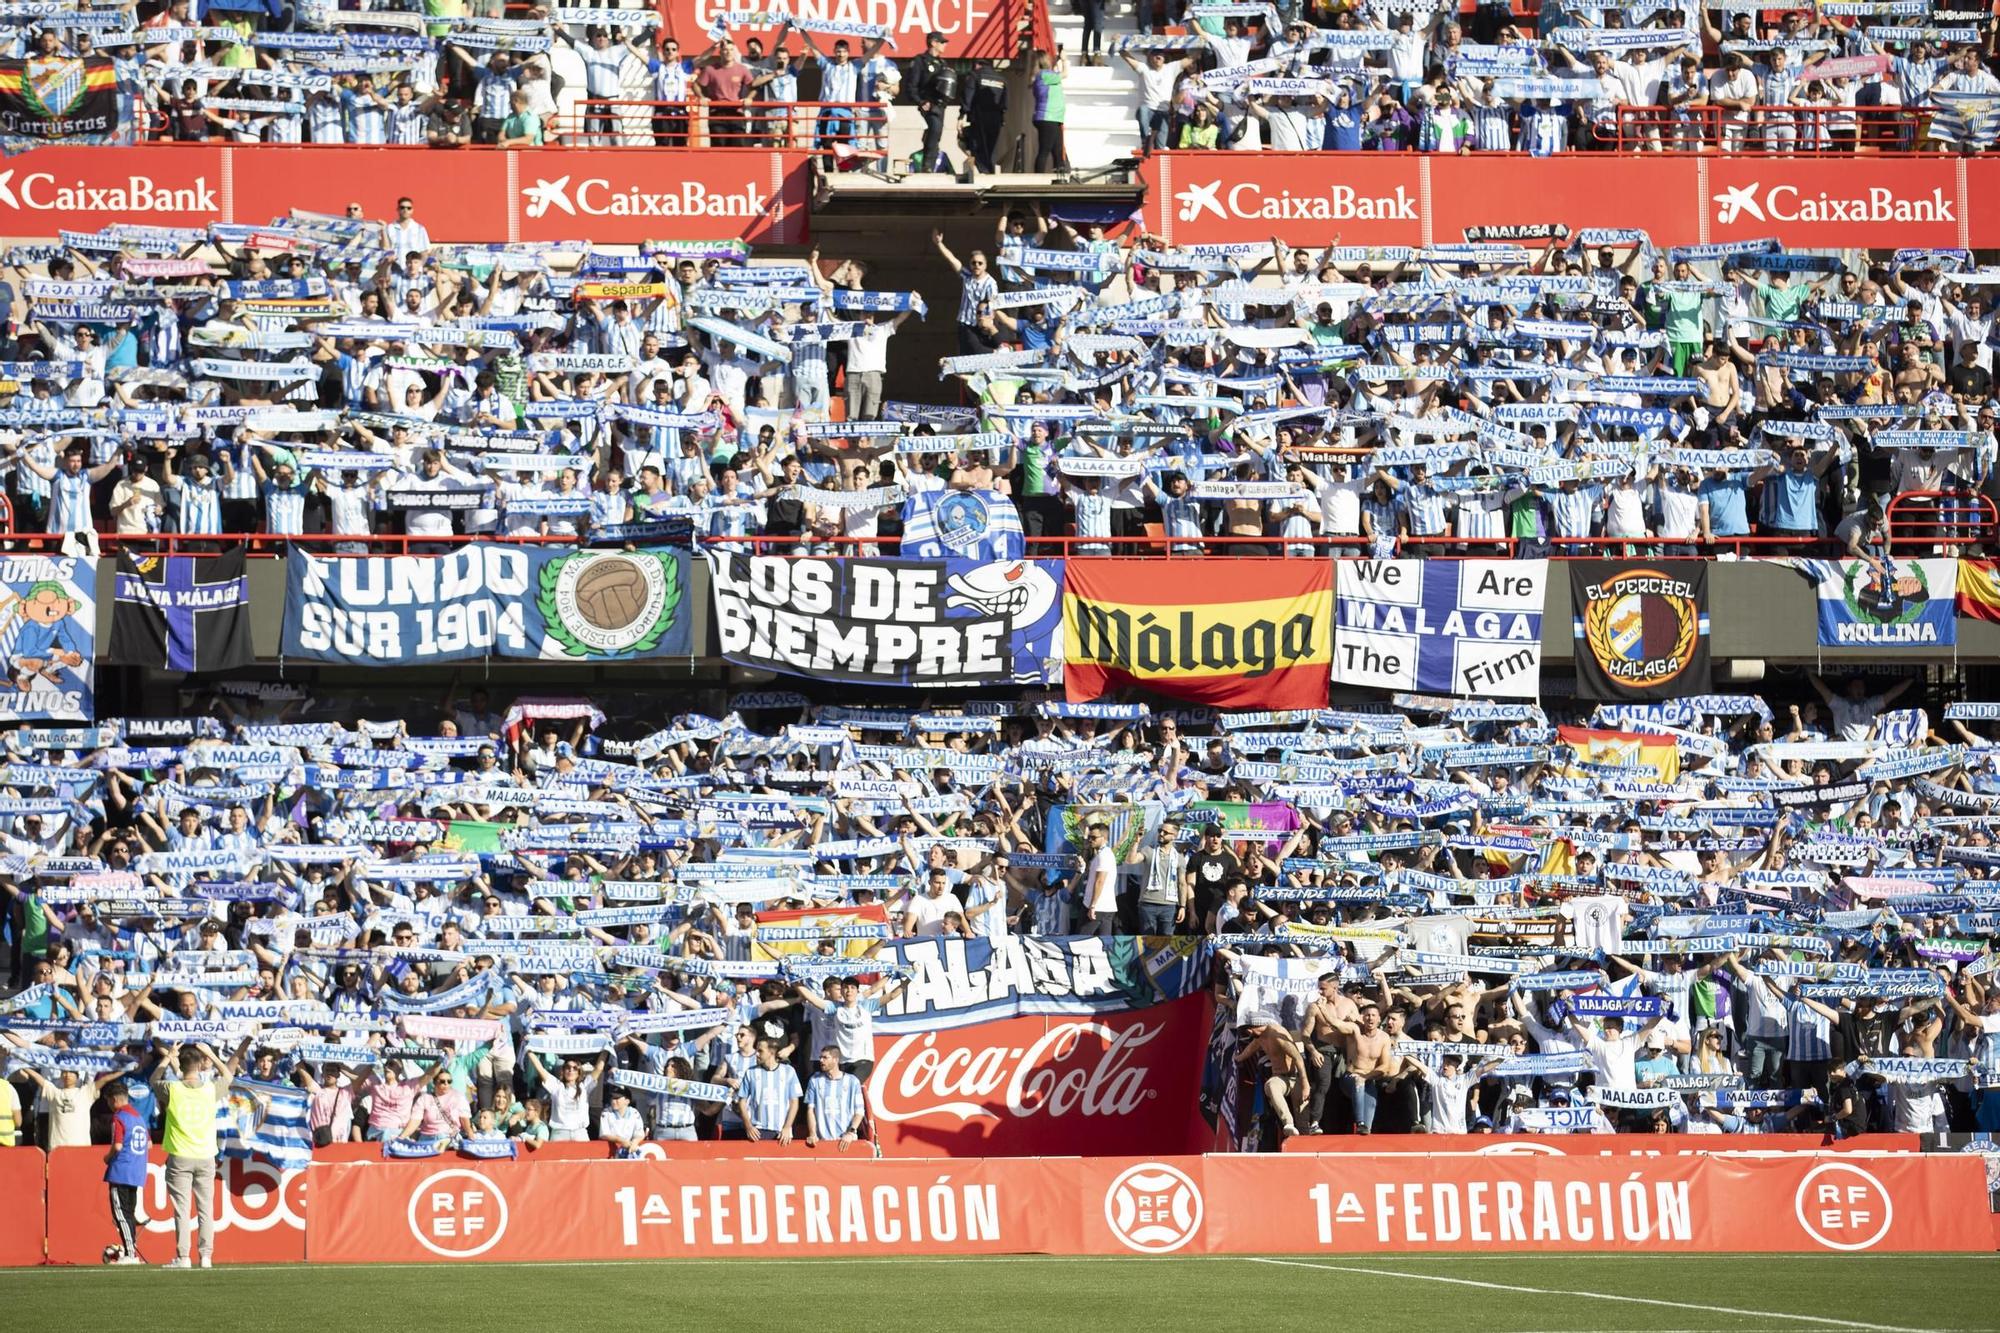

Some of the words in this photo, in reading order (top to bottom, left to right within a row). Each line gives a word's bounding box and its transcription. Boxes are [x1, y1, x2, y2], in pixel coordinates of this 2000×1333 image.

[563, 8, 599, 21] LOS
[602, 10, 643, 22] 300
[1827, 5, 1874, 15] FONDO
[1892, 3, 1920, 14] SUR
[805, 20, 879, 35] MALAGA
[1874, 28, 1923, 41] FONDO
[1941, 29, 1971, 41] SUR
[262, 32, 341, 48] MALAGA
[348, 34, 423, 49] MALAGA
[1326, 34, 1371, 45] MALAGA
[1550, 84, 1580, 93] MALAGA
[20, 172, 219, 212] CaixaBank
[576, 177, 766, 216] CaixaBank
[1229, 183, 1417, 220] CaixaBank
[1767, 185, 1956, 223] CaixaBank
[1485, 225, 1551, 241] MALAGA
[67, 234, 119, 249] FONDO
[1750, 257, 1818, 270] MALAGA
[1409, 278, 1477, 292] MALAGA
[1004, 293, 1025, 304] MCF
[1468, 288, 1531, 301] MALAGA
[33, 304, 77, 318] MALAKA
[80, 302, 132, 318] HINCHAS
[556, 356, 605, 370] MALAGA
[1785, 355, 1860, 371] MALAGA
[1419, 366, 1449, 380] SUR
[1609, 377, 1691, 393] MALAGA
[1495, 406, 1548, 418] MALAGA
[1549, 406, 1566, 418] C.F.
[1596, 408, 1665, 426] MALAGA
[1765, 420, 1836, 437] MALAGA
[488, 437, 537, 451] GRANDES
[905, 437, 955, 452] FONDO
[975, 435, 1006, 449] SUR
[1301, 451, 1357, 465] Malaga
[1383, 445, 1463, 462] MALAGA
[1679, 452, 1750, 464] MALAGA
[1063, 461, 1114, 473] MALAGA
[1593, 460, 1624, 475] SUR
[393, 494, 430, 507] SOMOS
[431, 494, 481, 507] GRANDES
[711, 549, 834, 614] LOS
[852, 564, 938, 623] DE
[1354, 560, 1402, 587] We
[1477, 569, 1533, 597] Are
[176, 586, 240, 607] MÁLAGA
[1585, 583, 1611, 600] EL
[1614, 578, 1695, 600] PERCHEL
[1347, 601, 1533, 640] MALAGA
[301, 602, 401, 659] SUR
[415, 599, 527, 655] 1904
[572, 618, 618, 647] DESDE
[719, 594, 1005, 676] SIEMPRE
[1837, 622, 1938, 643] MOLLINA
[1076, 599, 1316, 678] Málaga
[1341, 644, 1402, 675] The
[1462, 648, 1536, 694] Firm
[1450, 704, 1528, 718] MALAGA
[1680, 696, 1754, 712] MALAGA
[1949, 703, 1999, 718] FONDO
[129, 719, 193, 736] MALAGA
[250, 723, 325, 738] MALAGA
[921, 716, 996, 731] MALAGA
[1246, 734, 1303, 748] MALAGA
[212, 749, 282, 764] MALAGA
[344, 756, 408, 768] MALAGA
[771, 769, 807, 783] SOMOS
[1299, 766, 1333, 780] SUR
[485, 789, 534, 804] MALAGA
[1777, 789, 1818, 804] SOMOS
[1819, 784, 1868, 801] GRANDES
[1699, 807, 1779, 822] MALAGA
[348, 823, 415, 838] MALAGA
[822, 836, 893, 857] MALAGA
[47, 861, 94, 872] MALAGA
[166, 853, 238, 869] MALAGA
[1605, 863, 1685, 881] MALAGA
[1404, 872, 1459, 892] FONDO
[1479, 876, 1515, 891] SUR
[605, 883, 659, 897] FONDO
[1256, 886, 1328, 899] DEFIENDE
[843, 925, 879, 939] SUR
[1689, 937, 1725, 952] SUR
[520, 956, 595, 971] MALAGA
[1761, 960, 1813, 976] FONDO
[1511, 972, 1597, 988] MALAGA
[1806, 983, 1881, 997] DEFIENDE
[1578, 998, 1624, 1012] MALAGA
[1635, 1000, 1655, 1012] C.F.
[294, 1011, 372, 1027] MALAGA
[868, 1021, 1167, 1122] Coca-Cola
[1878, 1058, 1959, 1074] MALAGA
[1666, 1076, 1711, 1089] MALAGA
[688, 1084, 728, 1103] SUR
[1601, 1088, 1655, 1105] MALAGA
[1656, 1090, 1677, 1104] C.F.
[680, 1174, 1001, 1246] FEDERACIÓN
[1374, 1172, 1692, 1243] FEDERACIÓN
